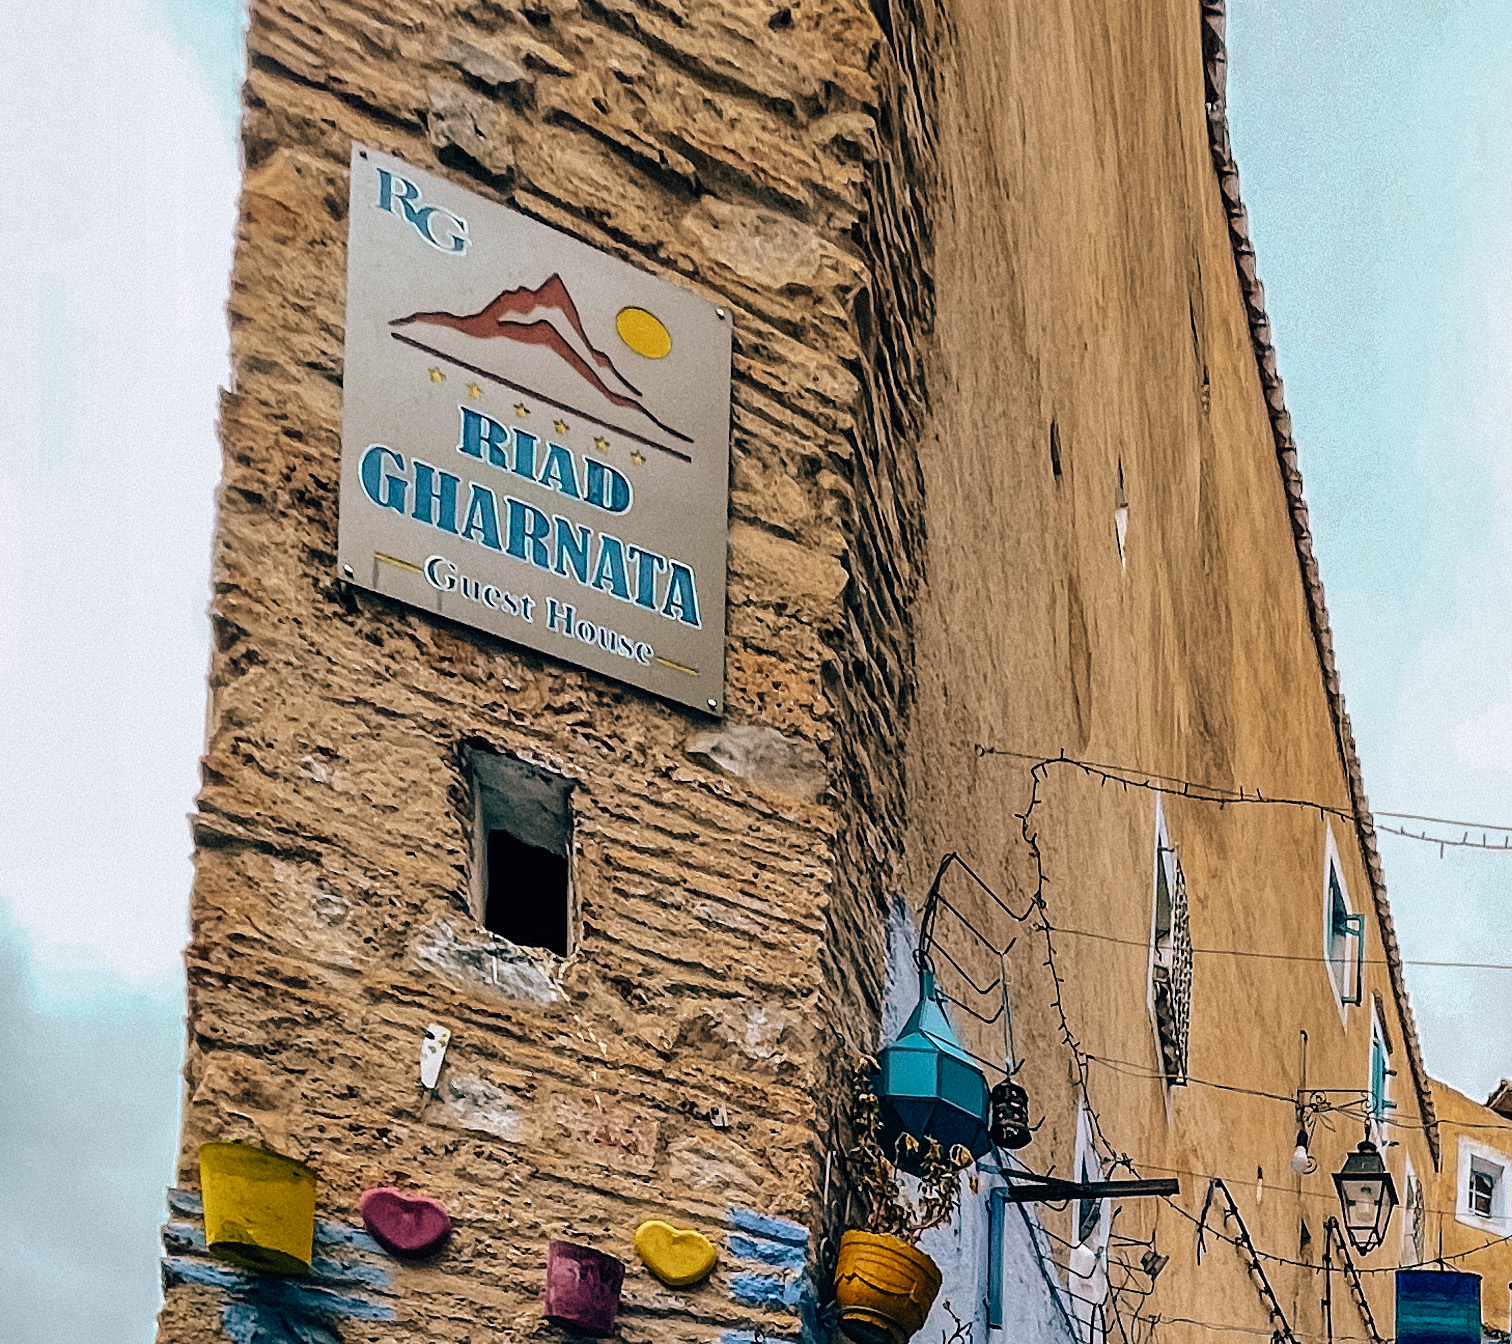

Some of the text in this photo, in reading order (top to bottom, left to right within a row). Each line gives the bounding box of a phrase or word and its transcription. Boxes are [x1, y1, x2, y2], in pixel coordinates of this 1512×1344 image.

[376, 167, 470, 255] RG
[458, 404, 634, 515] RIAD
[359, 443, 702, 630] GHARNATA
[424, 554, 656, 667] Guest House
